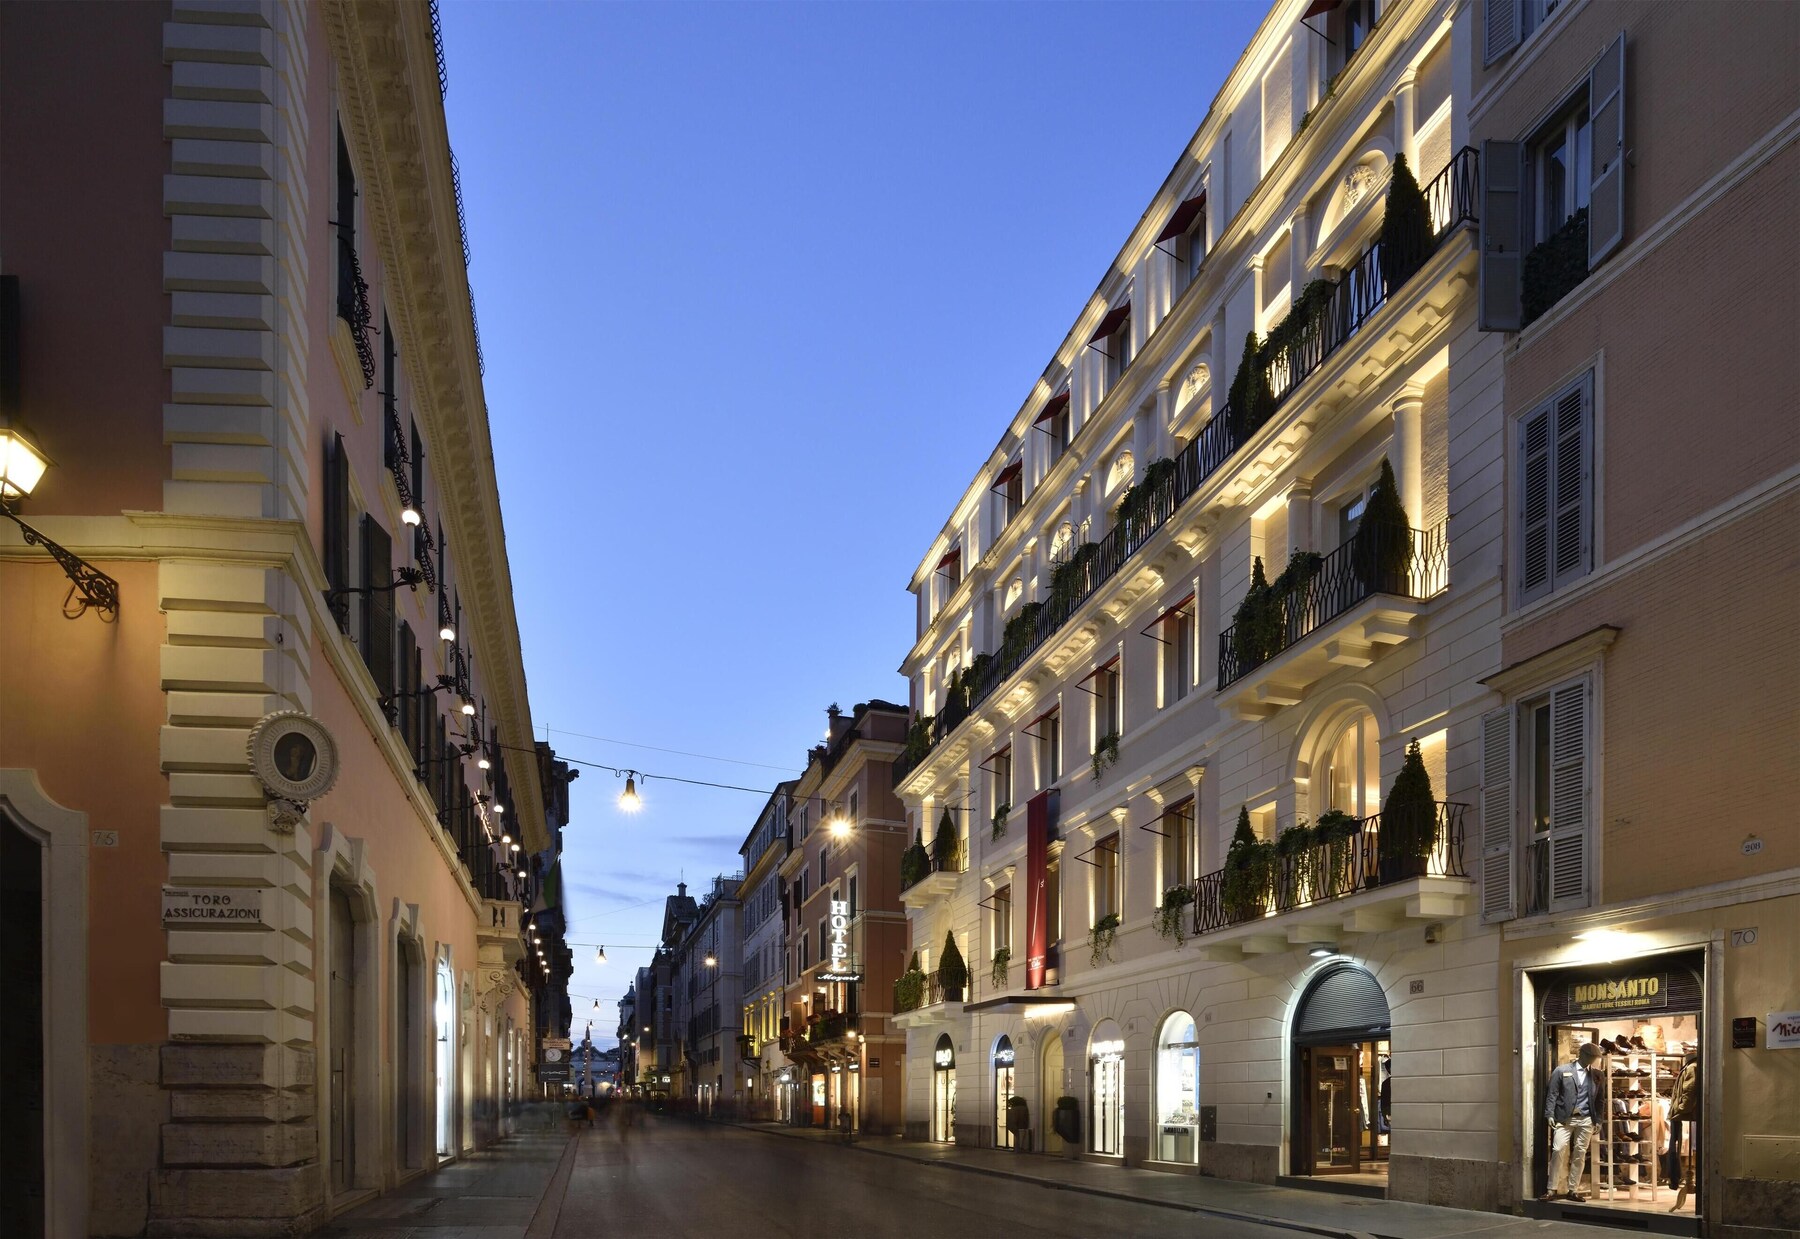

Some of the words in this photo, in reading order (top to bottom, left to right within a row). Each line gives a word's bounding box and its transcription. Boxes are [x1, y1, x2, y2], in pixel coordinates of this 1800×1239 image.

[93, 831, 114, 846] 75
[192, 895, 231, 905] TORO
[164, 908, 260, 919] ASSICURAZIONI
[831, 900, 848, 972] HOTEL
[1734, 930, 1756, 945] 70
[1411, 981, 1423, 993] 66
[1575, 977, 1659, 1002] MONSANTO
